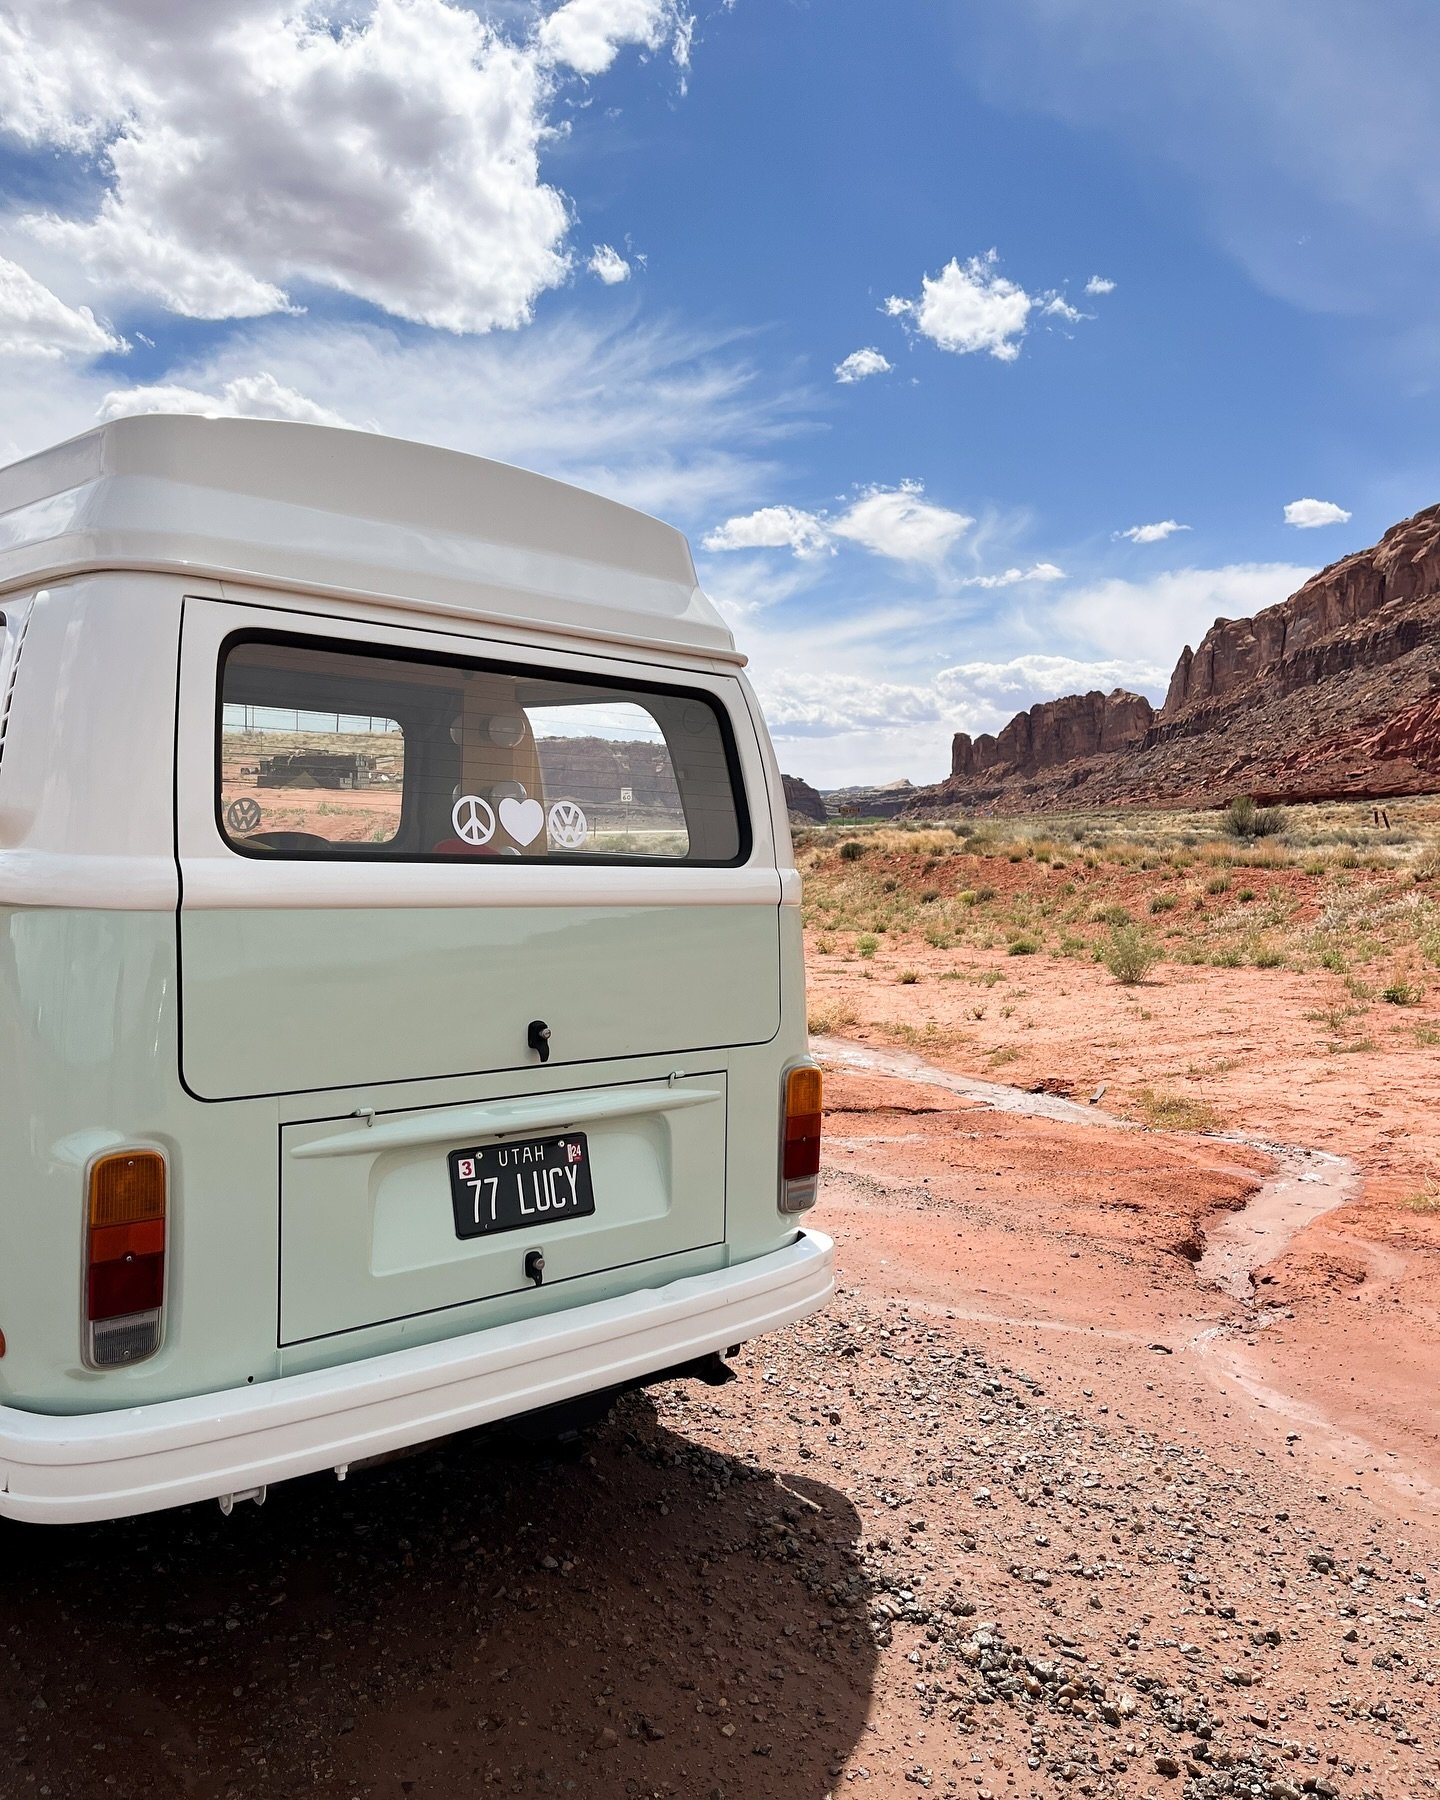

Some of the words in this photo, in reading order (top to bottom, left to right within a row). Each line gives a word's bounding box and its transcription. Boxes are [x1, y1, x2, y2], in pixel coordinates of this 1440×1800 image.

[228, 799, 261, 832] VW
[550, 802, 587, 847] VW
[498, 1145, 544, 1167] UTAH
[571, 1145, 581, 1156] 24
[461, 1160, 472, 1176] 3
[467, 1177, 498, 1223] 77
[517, 1165, 577, 1215] LUCY
